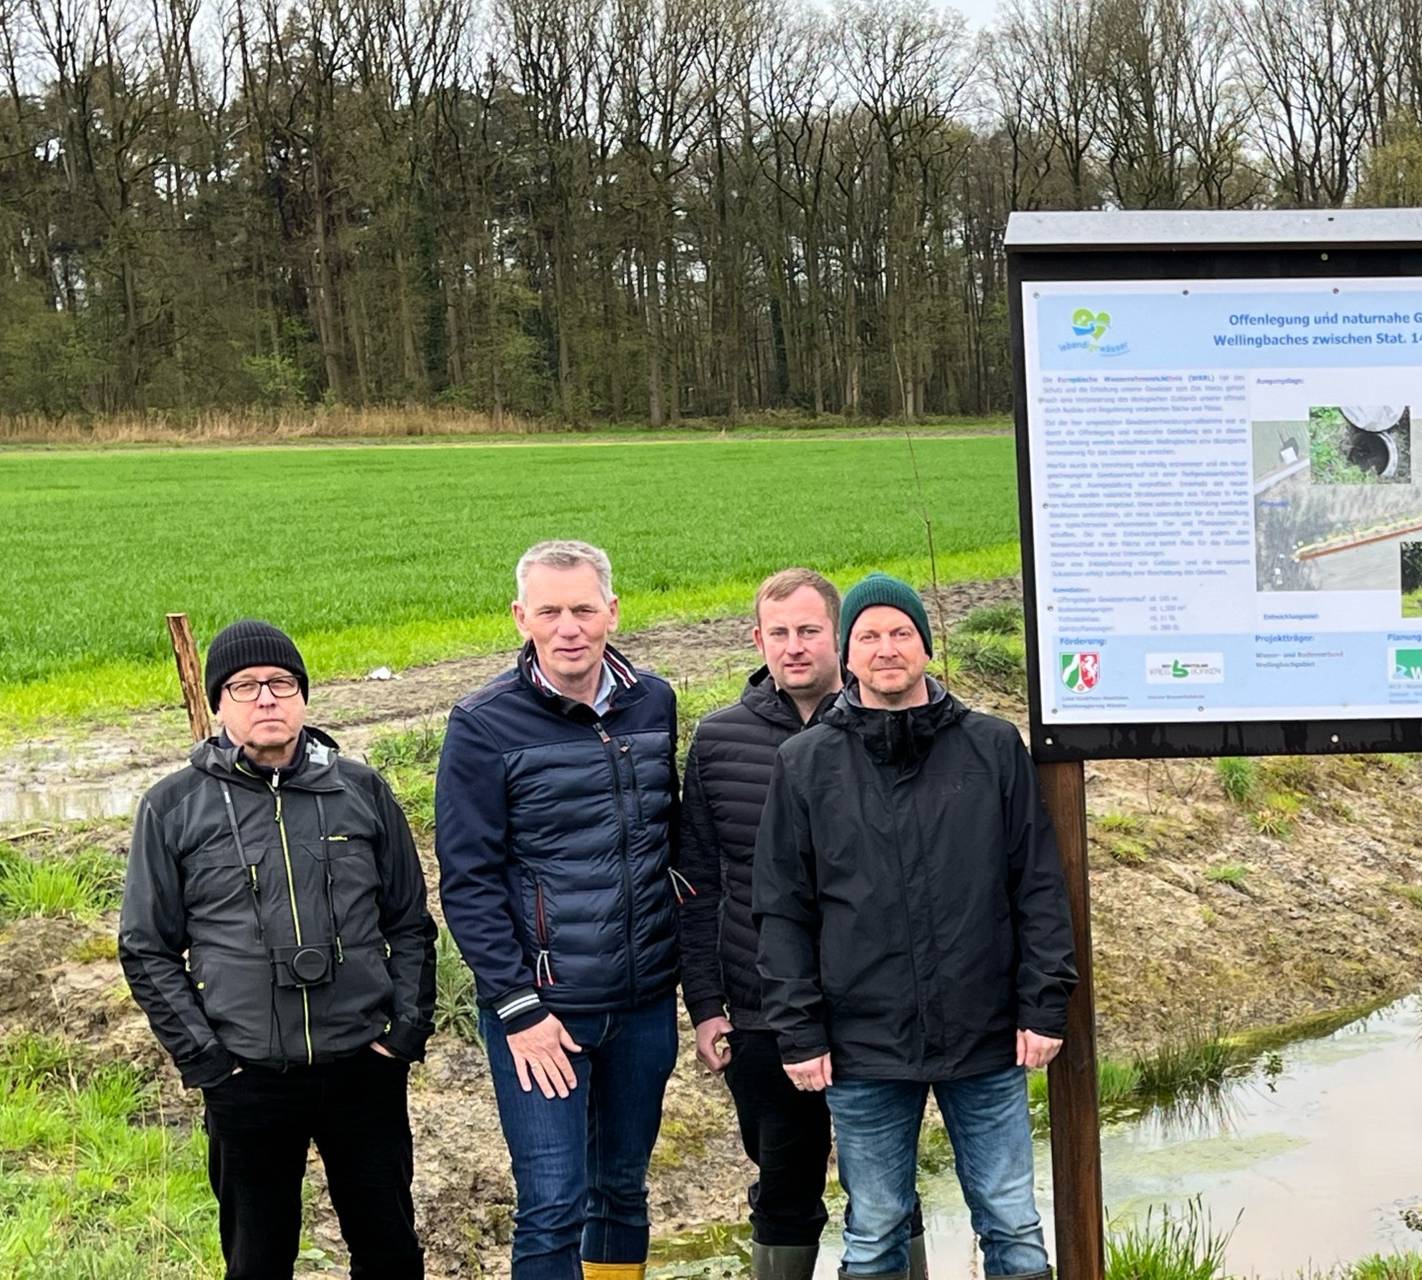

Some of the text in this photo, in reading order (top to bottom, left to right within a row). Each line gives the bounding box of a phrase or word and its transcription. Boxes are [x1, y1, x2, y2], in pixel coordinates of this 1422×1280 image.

[1229, 313, 1310, 328] Offenlegung
[1314, 312, 1338, 325] und
[1342, 312, 1410, 325] naturnahe
[1213, 334, 1309, 348] Wellingbaches
[1312, 333, 1372, 345] zwischen
[1376, 332, 1407, 344] Stat.
